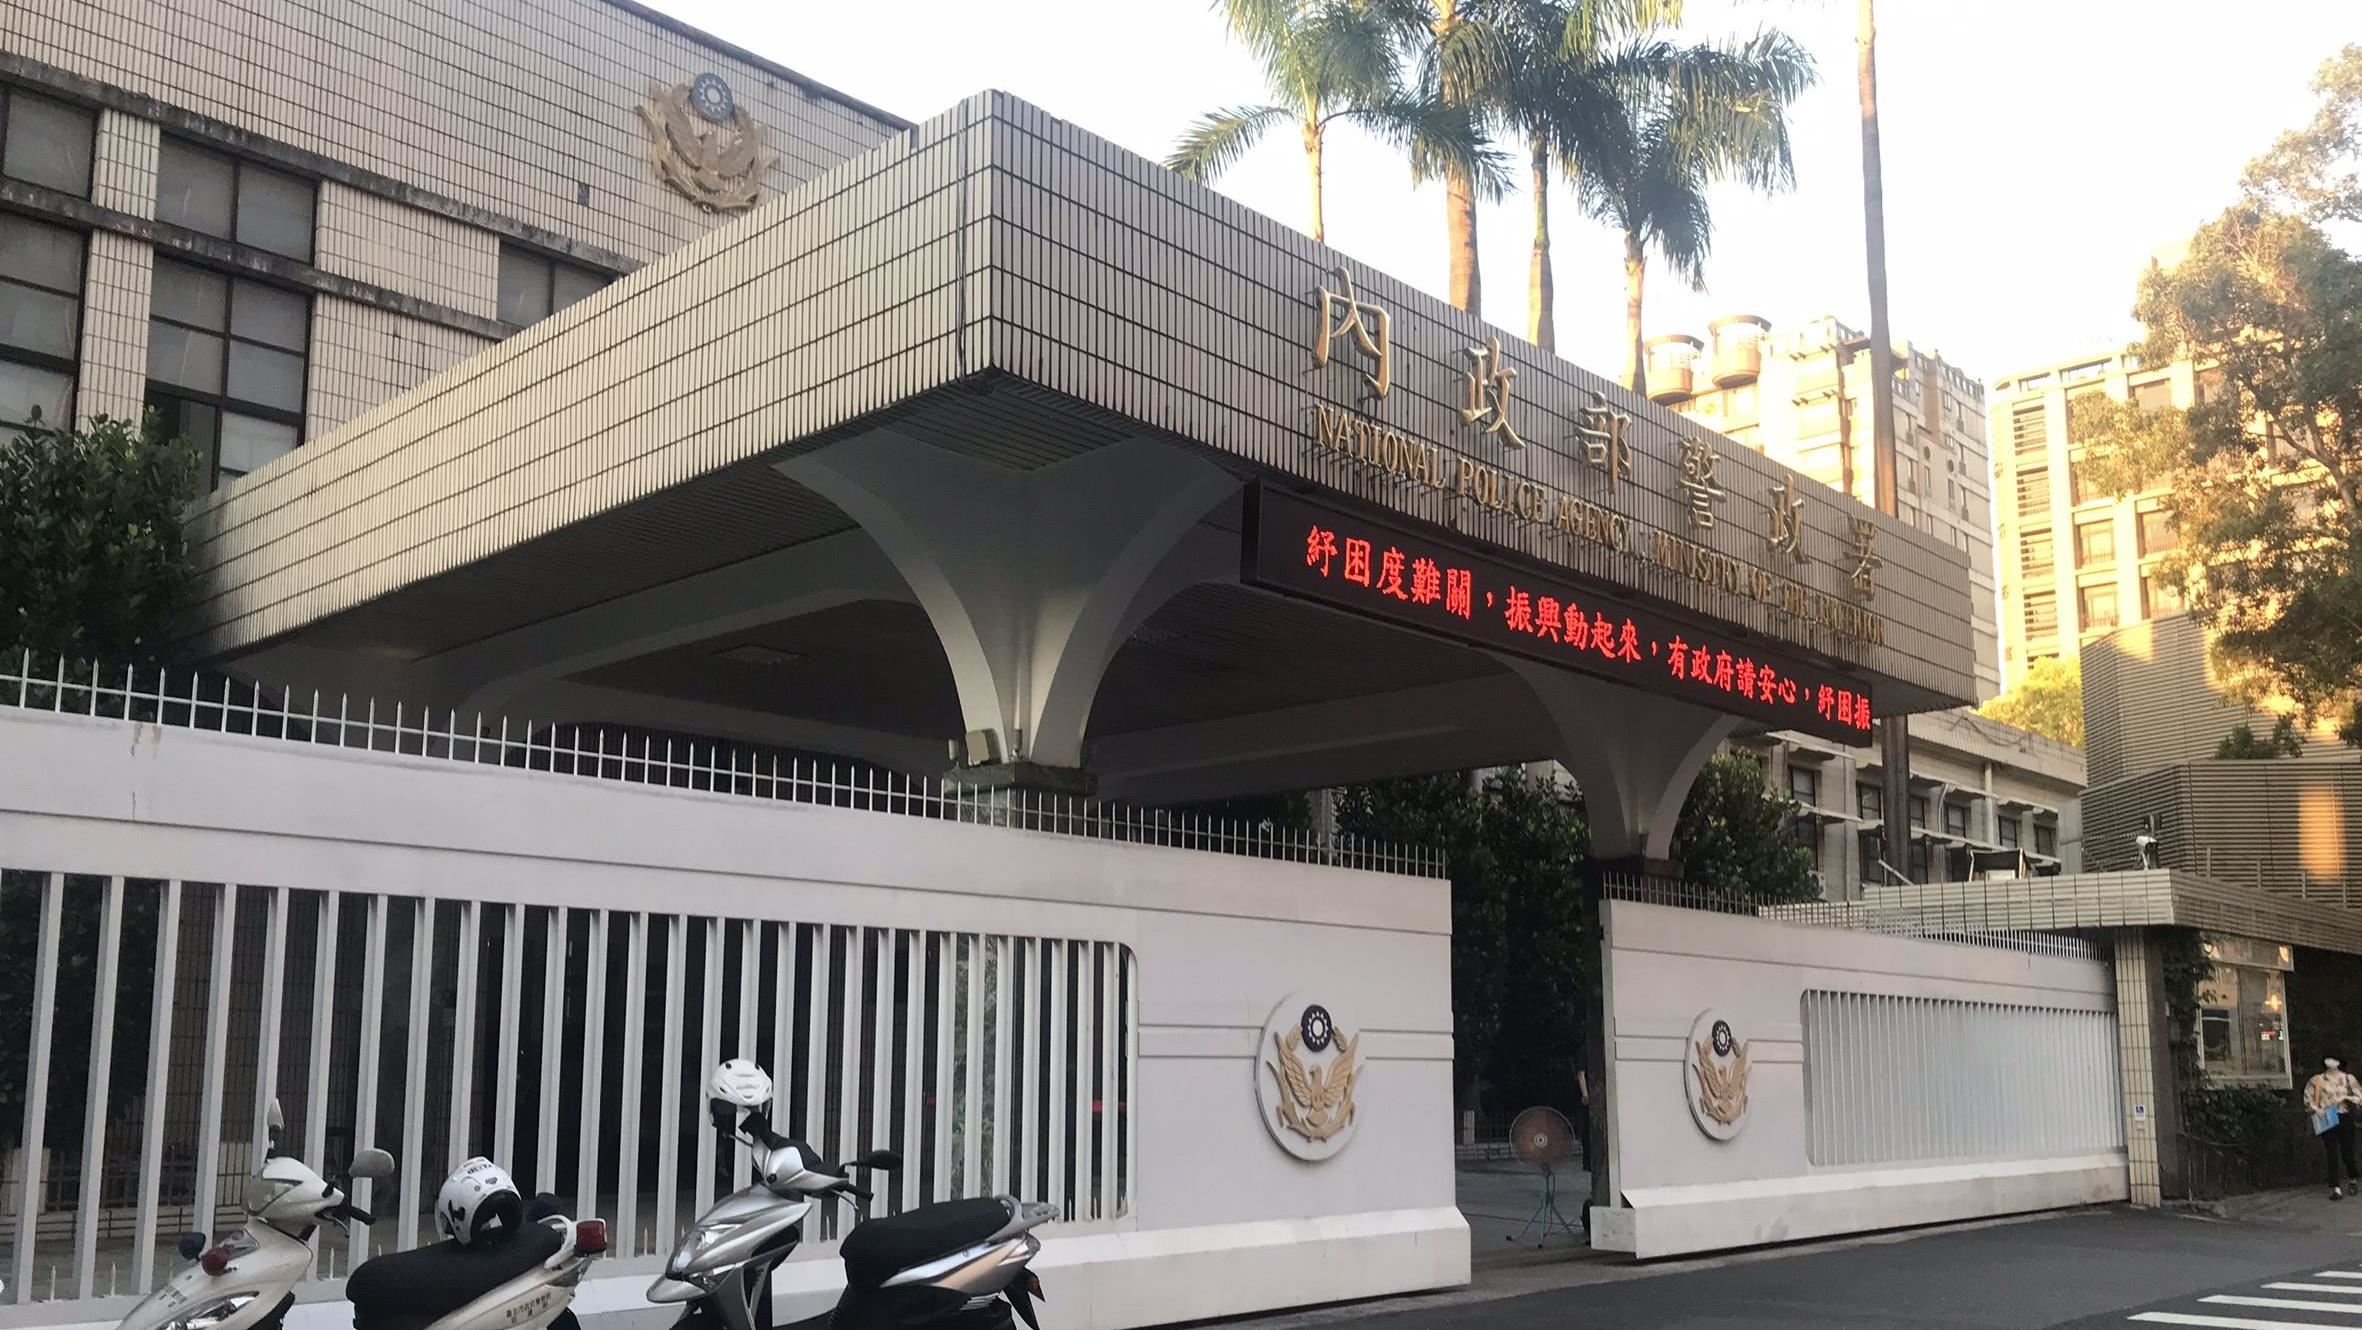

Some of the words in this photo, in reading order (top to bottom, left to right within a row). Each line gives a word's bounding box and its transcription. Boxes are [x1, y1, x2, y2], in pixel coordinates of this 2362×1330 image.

[1312, 266, 1884, 601] 內政部警政署
[1313, 403, 1446, 489] NATIONAL
[1457, 456, 1546, 522] POLICE
[1654, 529, 1742, 594] MINISTRY
[1751, 566, 1772, 602] OF
